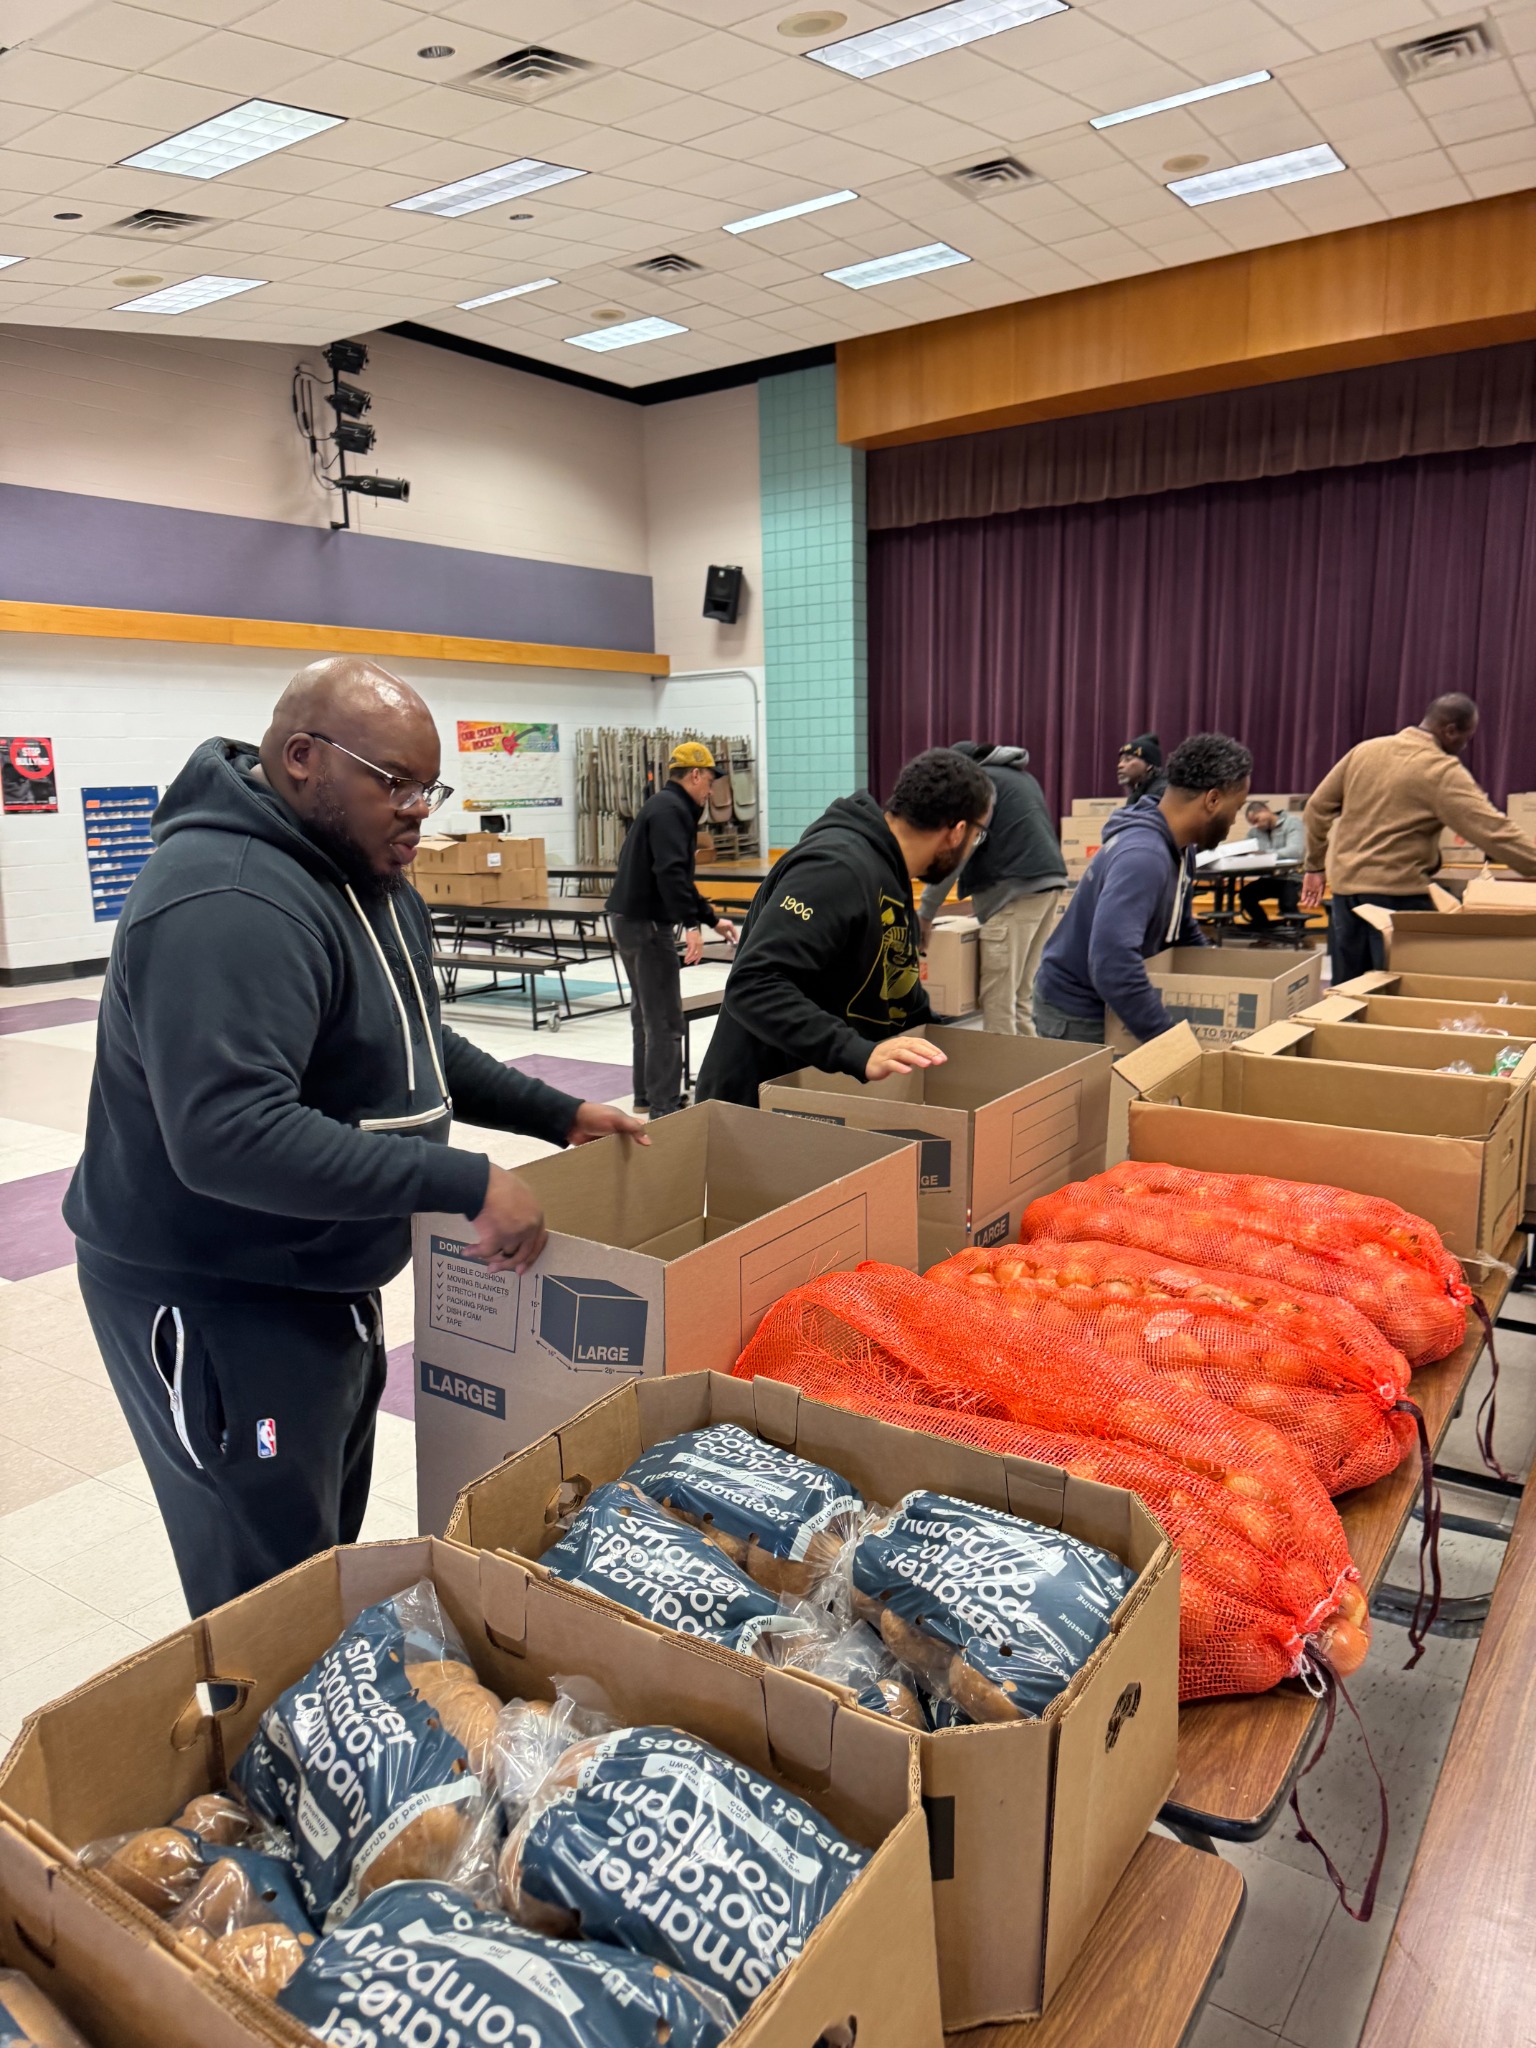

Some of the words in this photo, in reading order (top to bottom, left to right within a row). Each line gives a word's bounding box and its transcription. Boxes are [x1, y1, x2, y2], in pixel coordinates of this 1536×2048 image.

[461, 731, 475, 741] OUR
[477, 726, 503, 738] SCHOOL
[472, 738, 495, 750] ROCKS
[15, 757, 50, 766] BULLYING
[21, 747, 41, 757] STOP
[780, 895, 814, 921] 1906
[1203, 1028, 1217, 1037] TO
[978, 1218, 1006, 1247] LARGE
[447, 1263, 474, 1276] BUBBLE
[475, 1270, 506, 1284] CUSHION
[447, 1274, 474, 1287] MOVING
[474, 1281, 509, 1296] BLANKETS
[446, 1296, 476, 1309] PACKING
[477, 1304, 498, 1315] PAPER
[447, 1285, 477, 1298] STRETCH
[478, 1292, 494, 1303] FILM
[446, 1306, 462, 1316] DISH
[463, 1312, 482, 1321] FOAM
[446, 1316, 463, 1327] TAPE
[577, 1344, 629, 1362] LARGE
[428, 1369, 497, 1411] LARGE
[693, 1440, 833, 1492] company
[641, 1470, 698, 1485] russet
[693, 1476, 794, 1522] potatoes
[619, 1516, 750, 1604] smarter
[599, 1533, 714, 1613] potato
[887, 1552, 1012, 1647] smarter
[1076, 1594, 1111, 1625] mashing
[1058, 1613, 1094, 1643] roasting
[1053, 1664, 1070, 1681] est
[346, 1639, 417, 1745] smarter
[320, 1660, 375, 1755] potato
[294, 1692, 372, 1839] company
[669, 1758, 699, 1777] grown
[728, 1807, 749, 1823] non-
[730, 1799, 752, 1819] gmo
[359, 1830, 388, 1864] scrub
[388, 1818, 402, 1832] or
[401, 1792, 432, 1818] peel!
[770, 1796, 863, 1866] russet
[784, 1844, 799, 1864] 3x
[626, 1826, 790, 1957] potato
[578, 1847, 763, 1999] smarter
